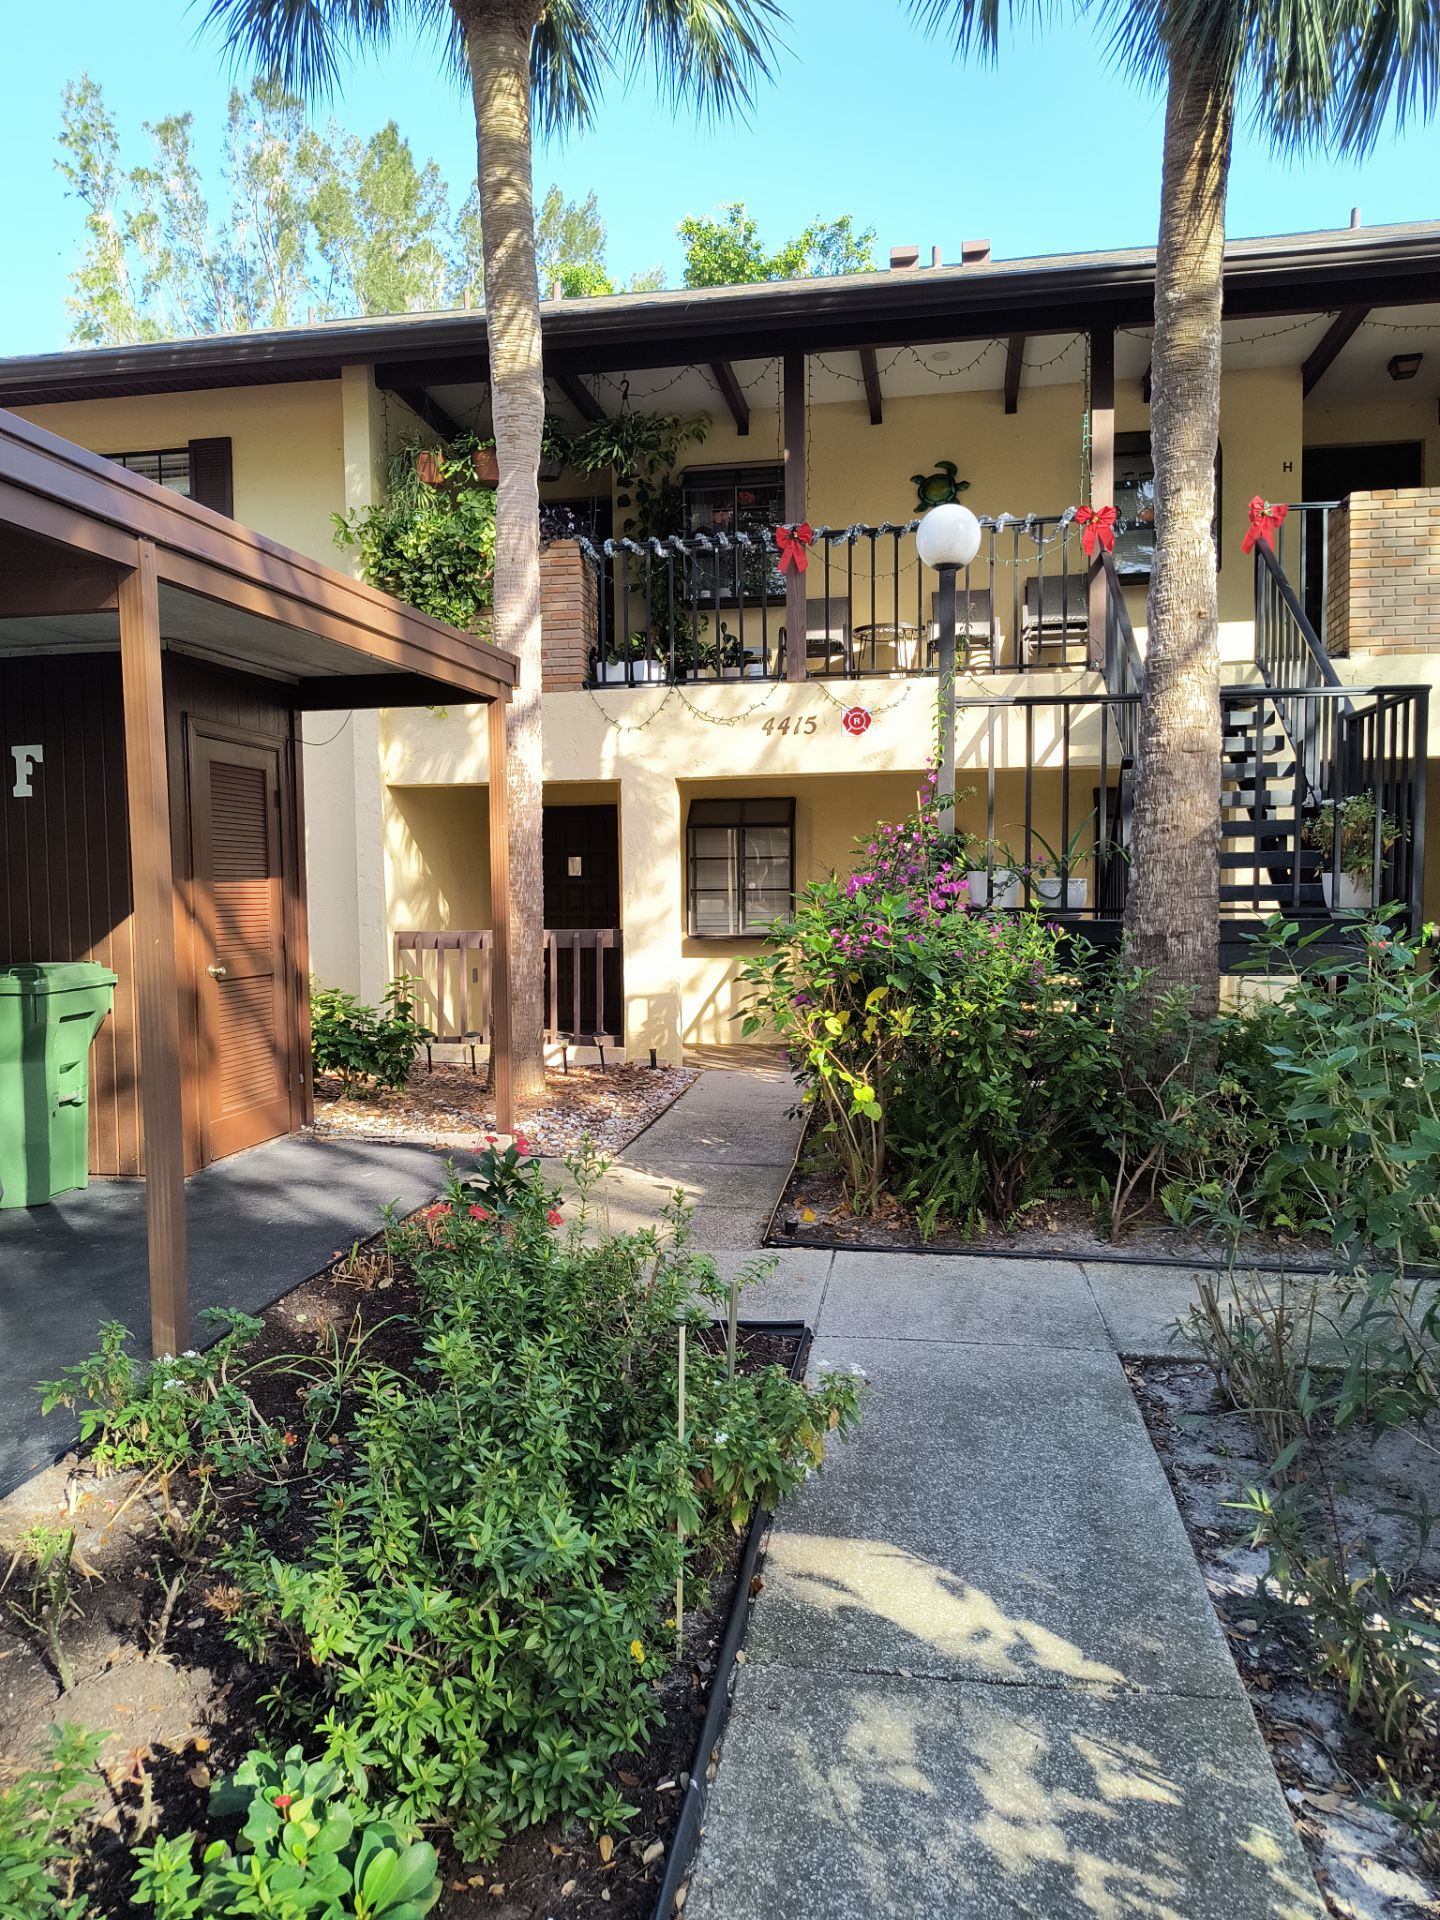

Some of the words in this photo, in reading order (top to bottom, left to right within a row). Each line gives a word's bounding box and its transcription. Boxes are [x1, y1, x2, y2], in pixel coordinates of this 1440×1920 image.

[1283, 461, 1293, 473] H
[762, 715, 817, 736] 4415
[11, 744, 44, 798] F
